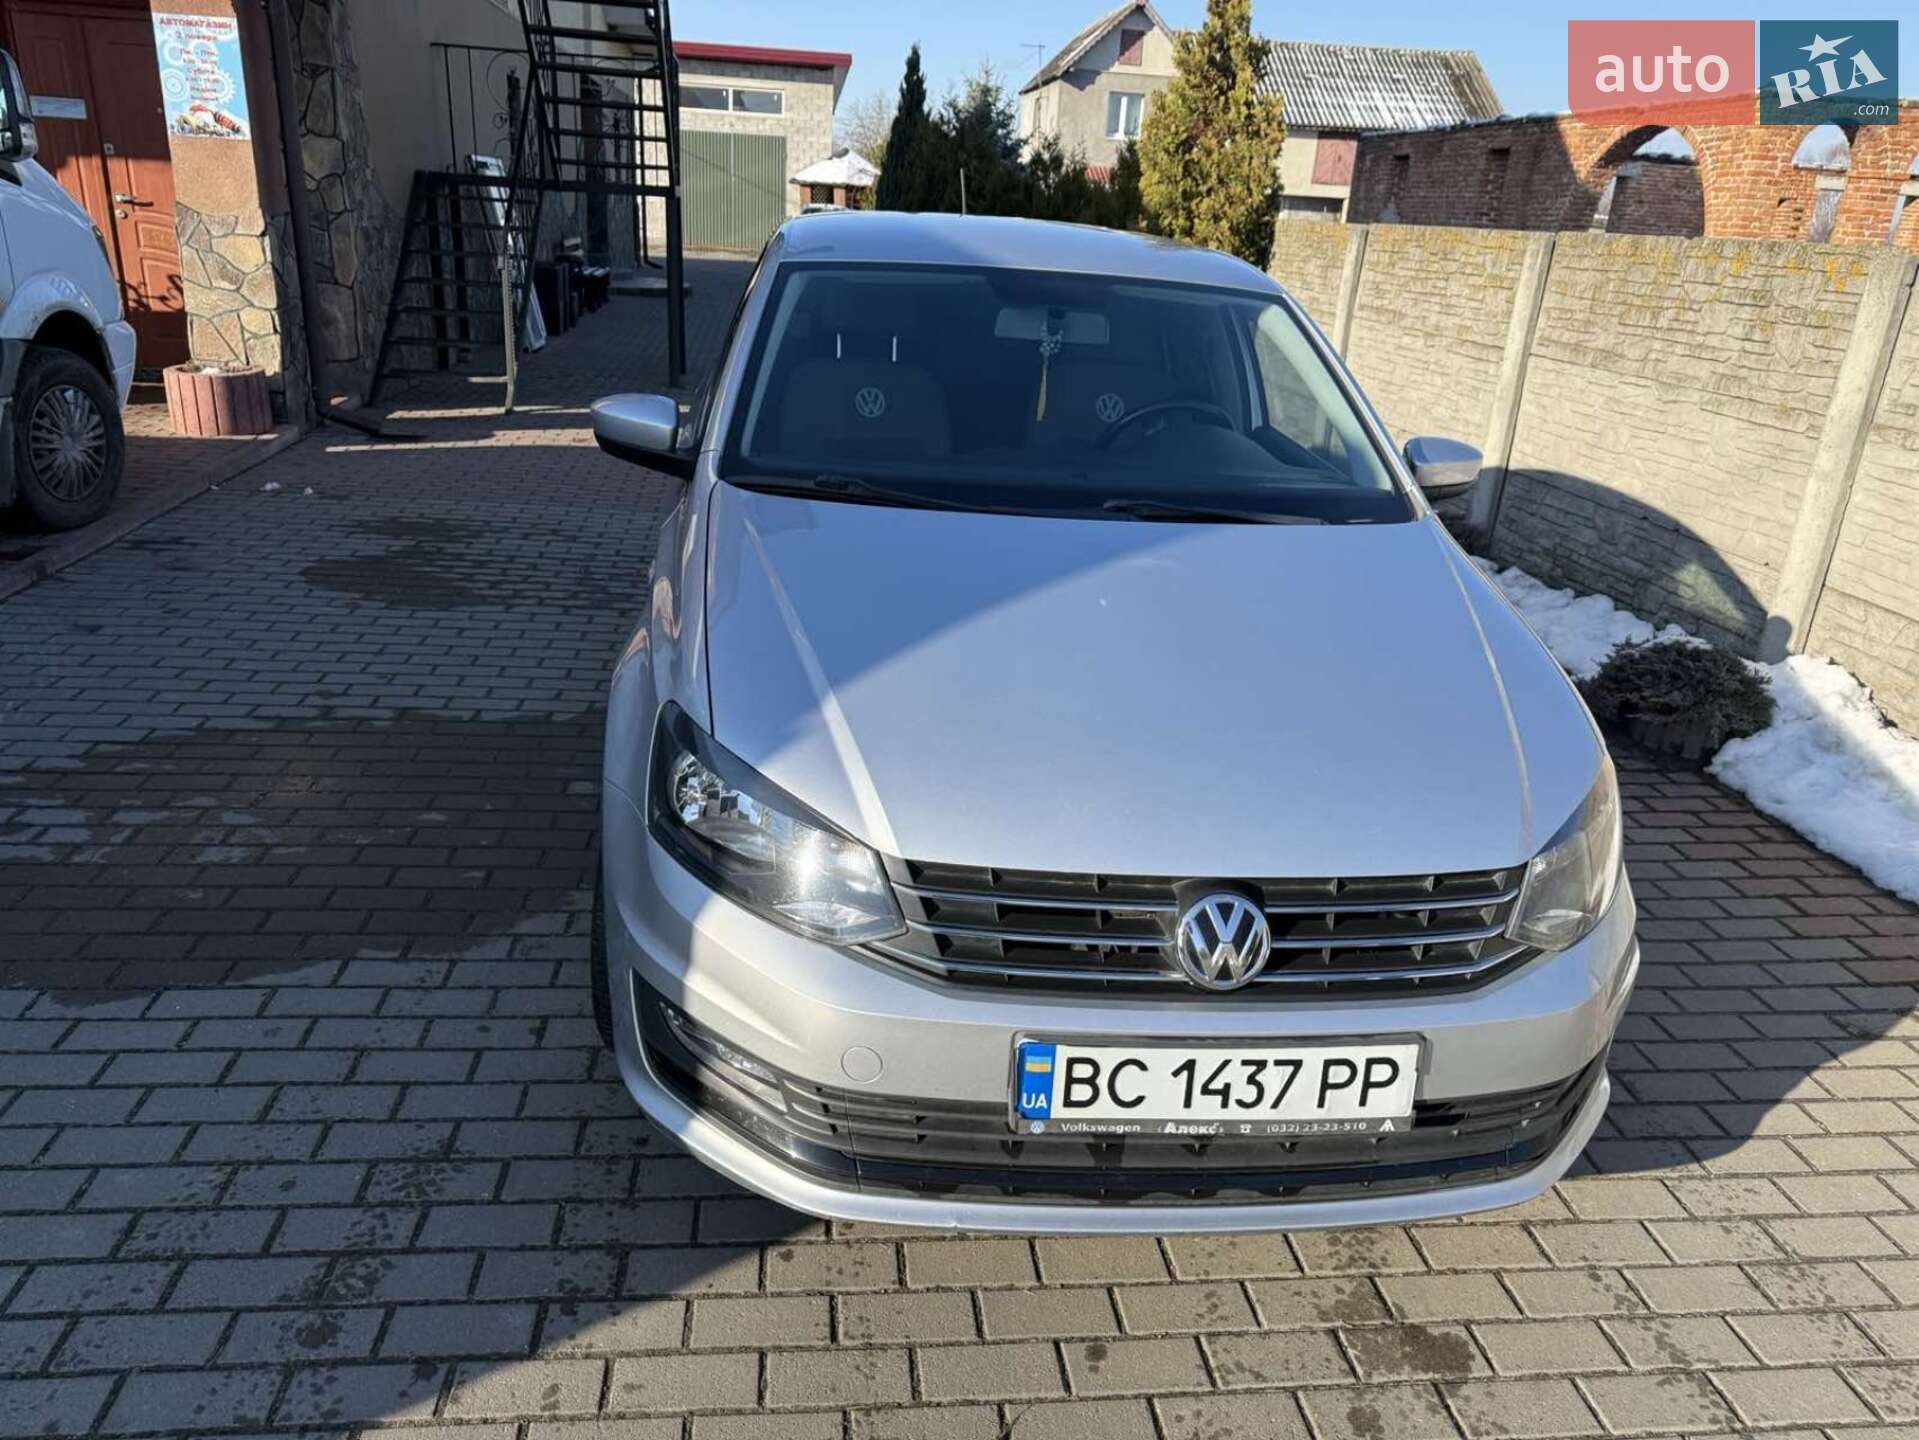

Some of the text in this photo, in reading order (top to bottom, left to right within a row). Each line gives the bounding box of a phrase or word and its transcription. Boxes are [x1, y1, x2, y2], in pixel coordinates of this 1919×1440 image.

[160, 18, 231, 29] АВТОМАГАЗИН
[1062, 1056, 1400, 1110] BC 1437 PP
[1022, 1092, 1048, 1109] UA
[1061, 1122, 1141, 1134] Volkswagen
[1266, 1123, 1300, 1134] (032)
[1302, 1121, 1367, 1133] 23-23-510
